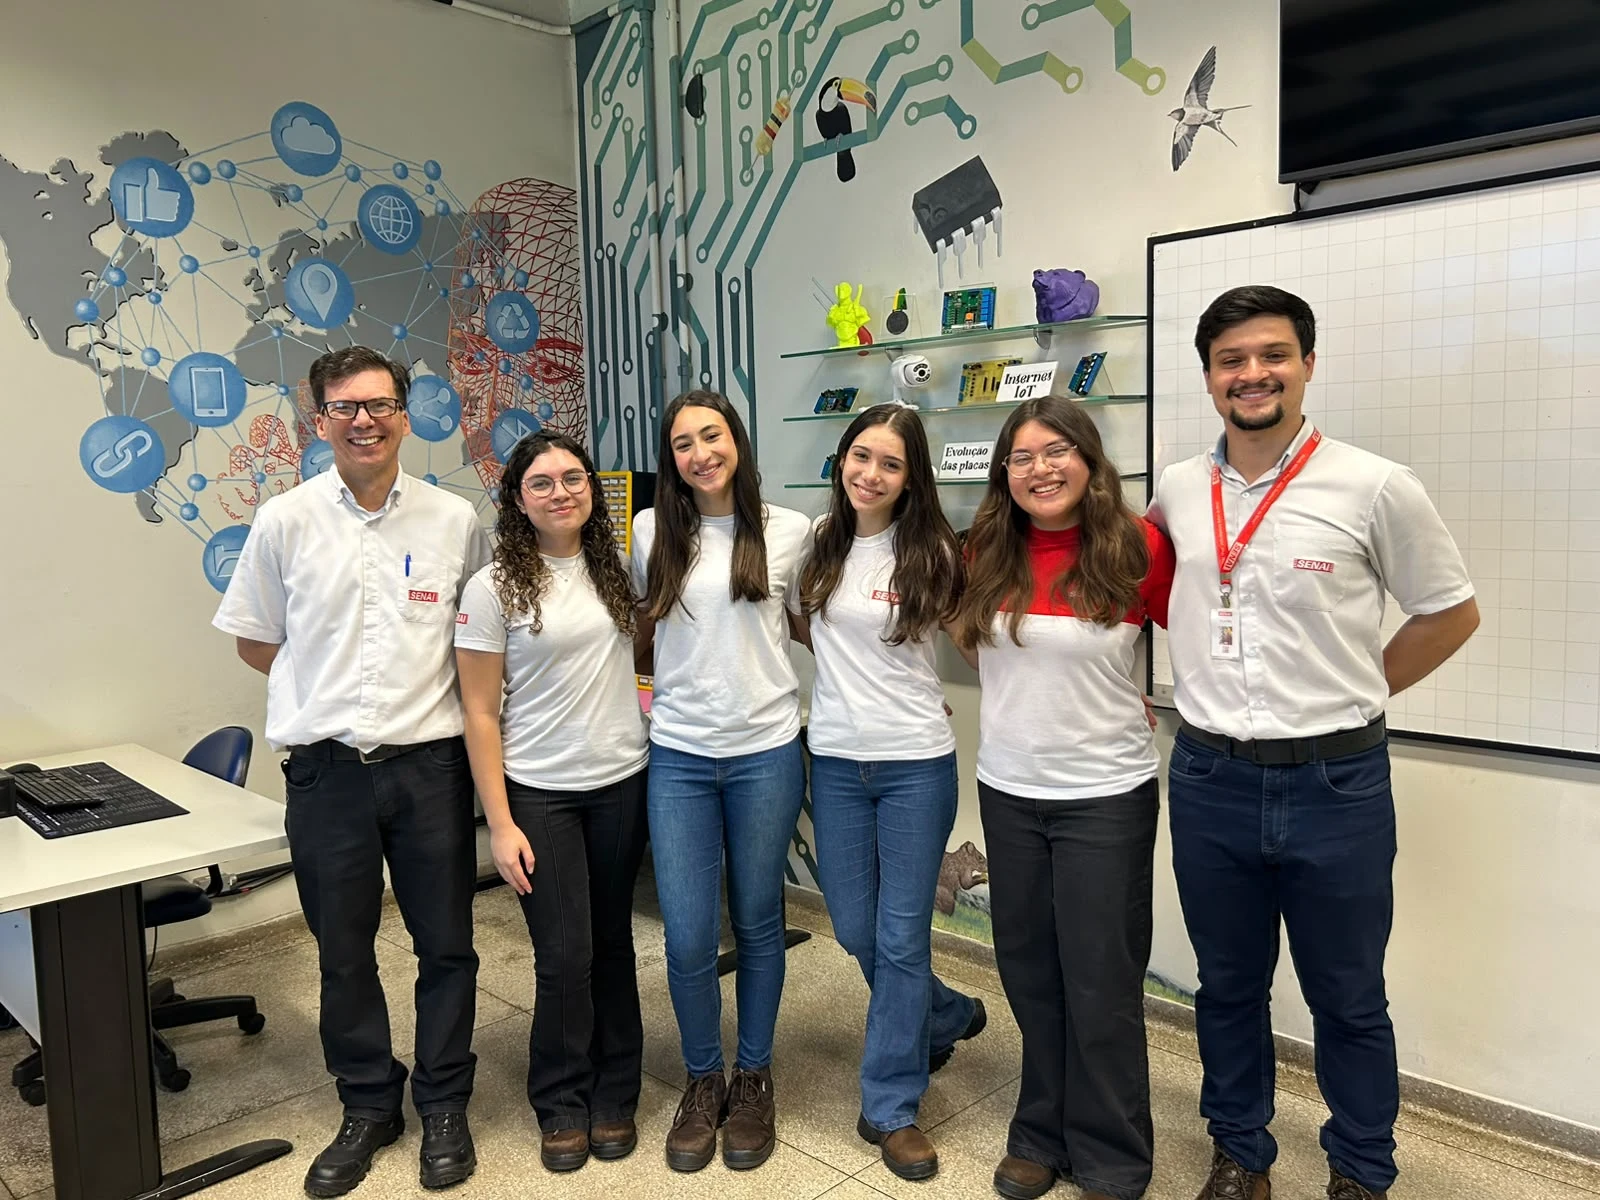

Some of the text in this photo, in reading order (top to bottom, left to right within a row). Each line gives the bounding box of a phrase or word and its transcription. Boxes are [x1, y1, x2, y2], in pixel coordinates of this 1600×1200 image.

[1004, 370, 1053, 385] Internet
[1014, 385, 1036, 398] IoT
[941, 460, 990, 475] das placas
[1224, 544, 1241, 570] SENAI
[1297, 559, 1331, 572] SENAI
[409, 590, 436, 602] SENAI
